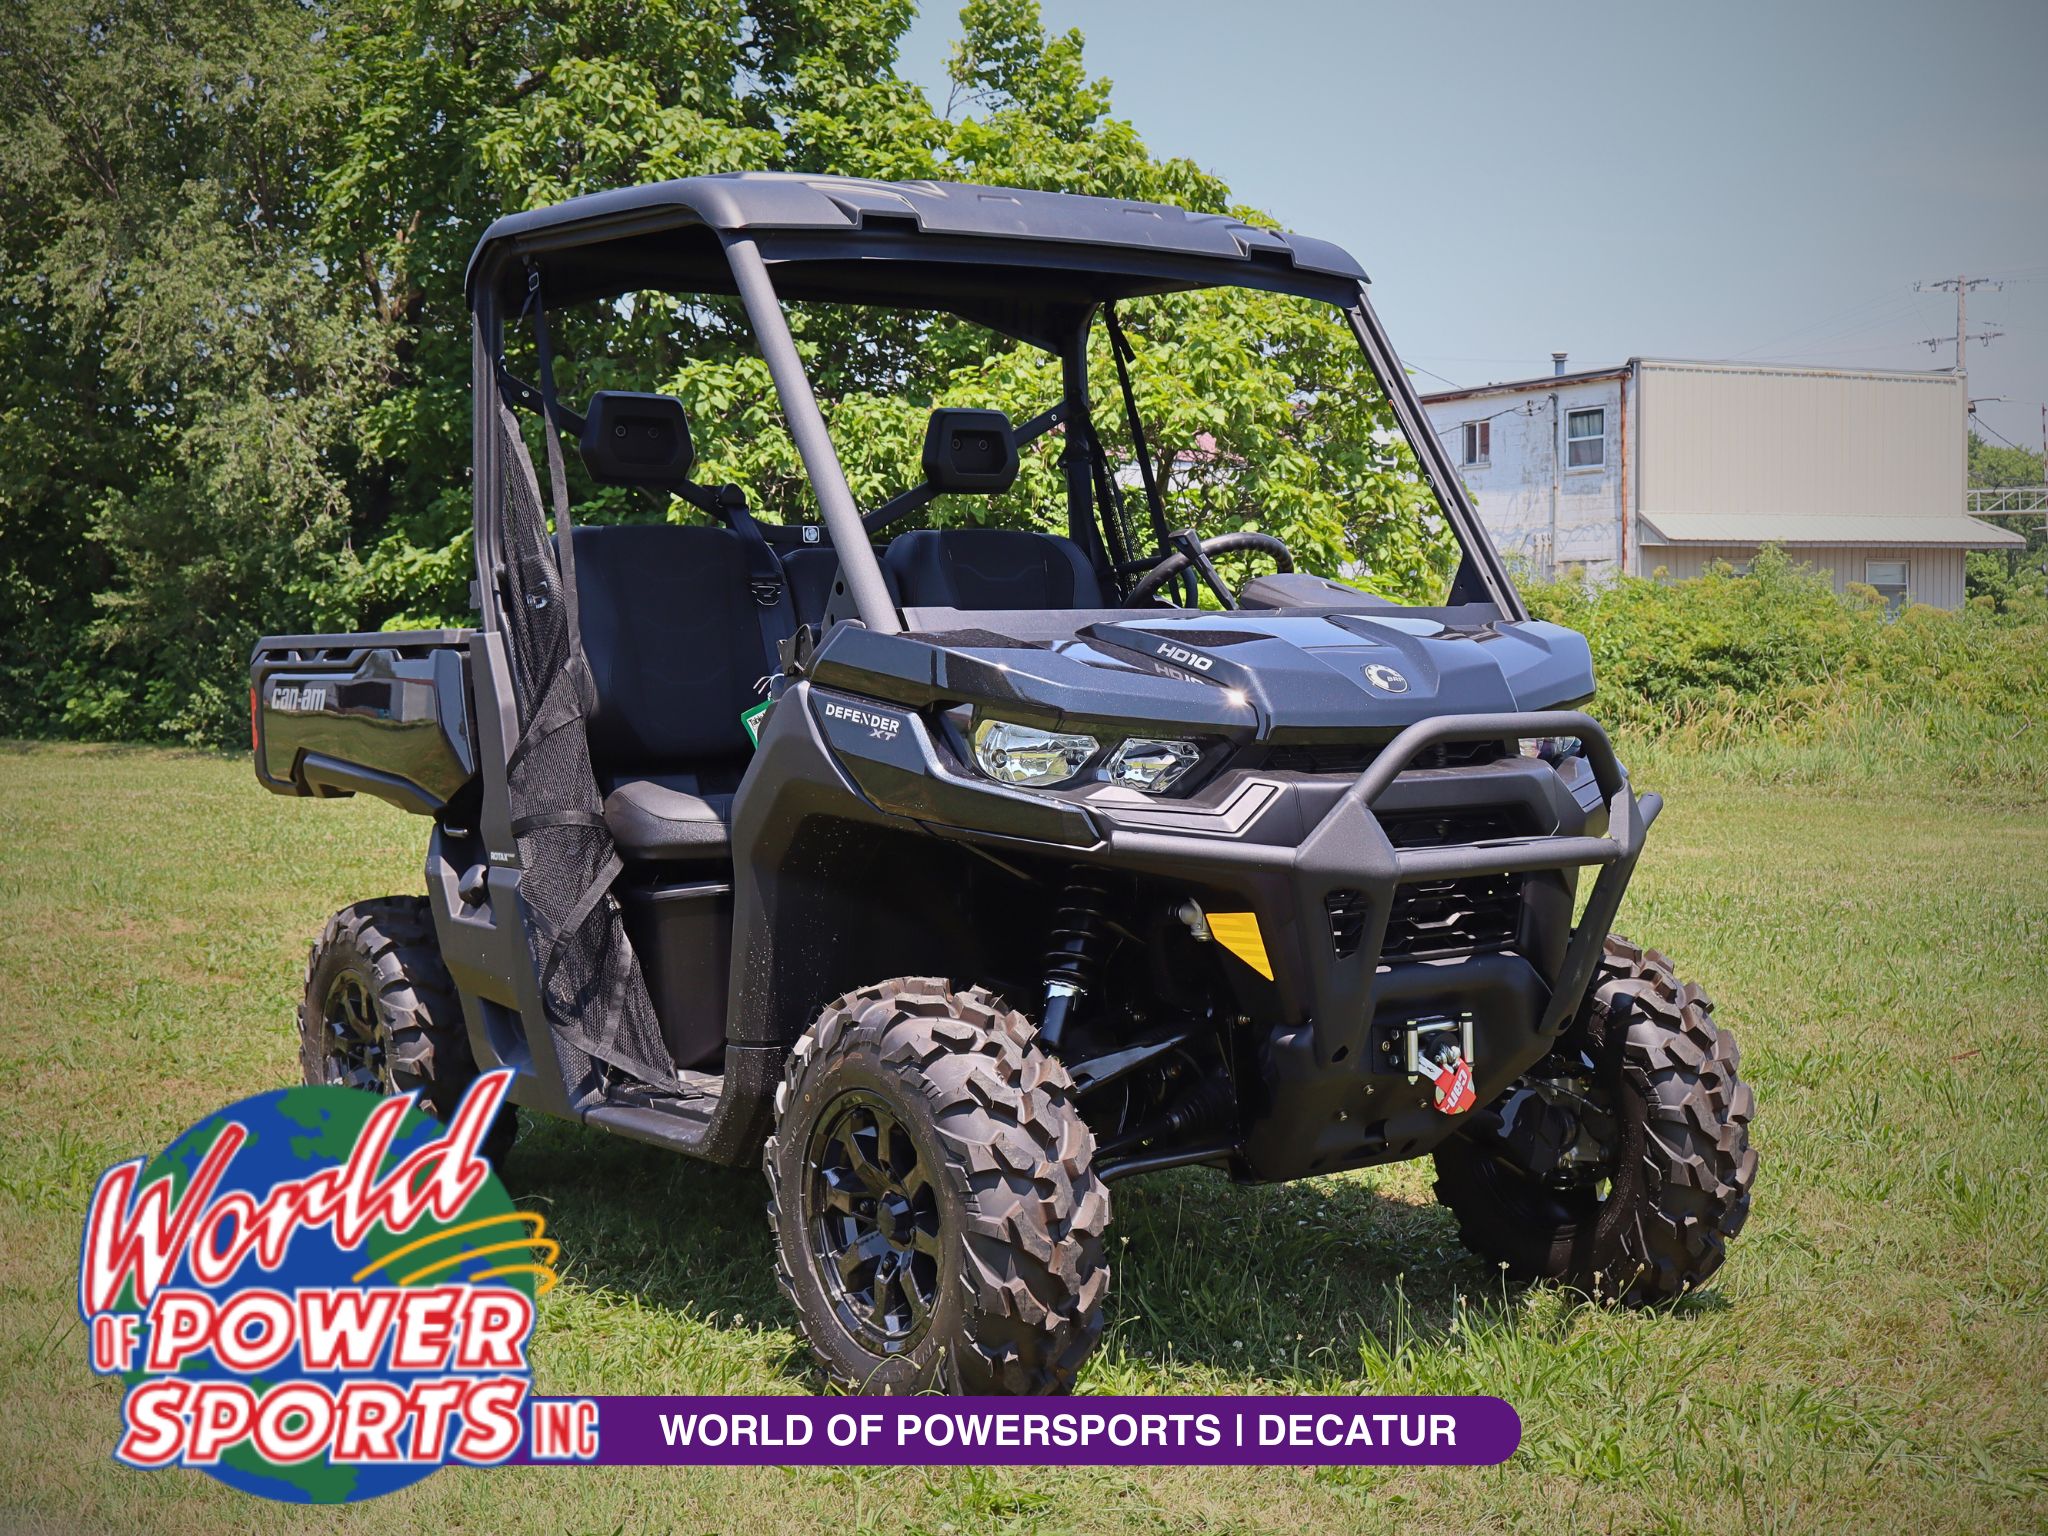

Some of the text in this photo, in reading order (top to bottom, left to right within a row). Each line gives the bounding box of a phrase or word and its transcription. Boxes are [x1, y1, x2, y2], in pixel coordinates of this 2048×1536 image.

[1156, 642, 1213, 671] HD10
[271, 687, 327, 711] can-am
[825, 703, 900, 733] DEFENDER
[869, 728, 897, 741] XT
